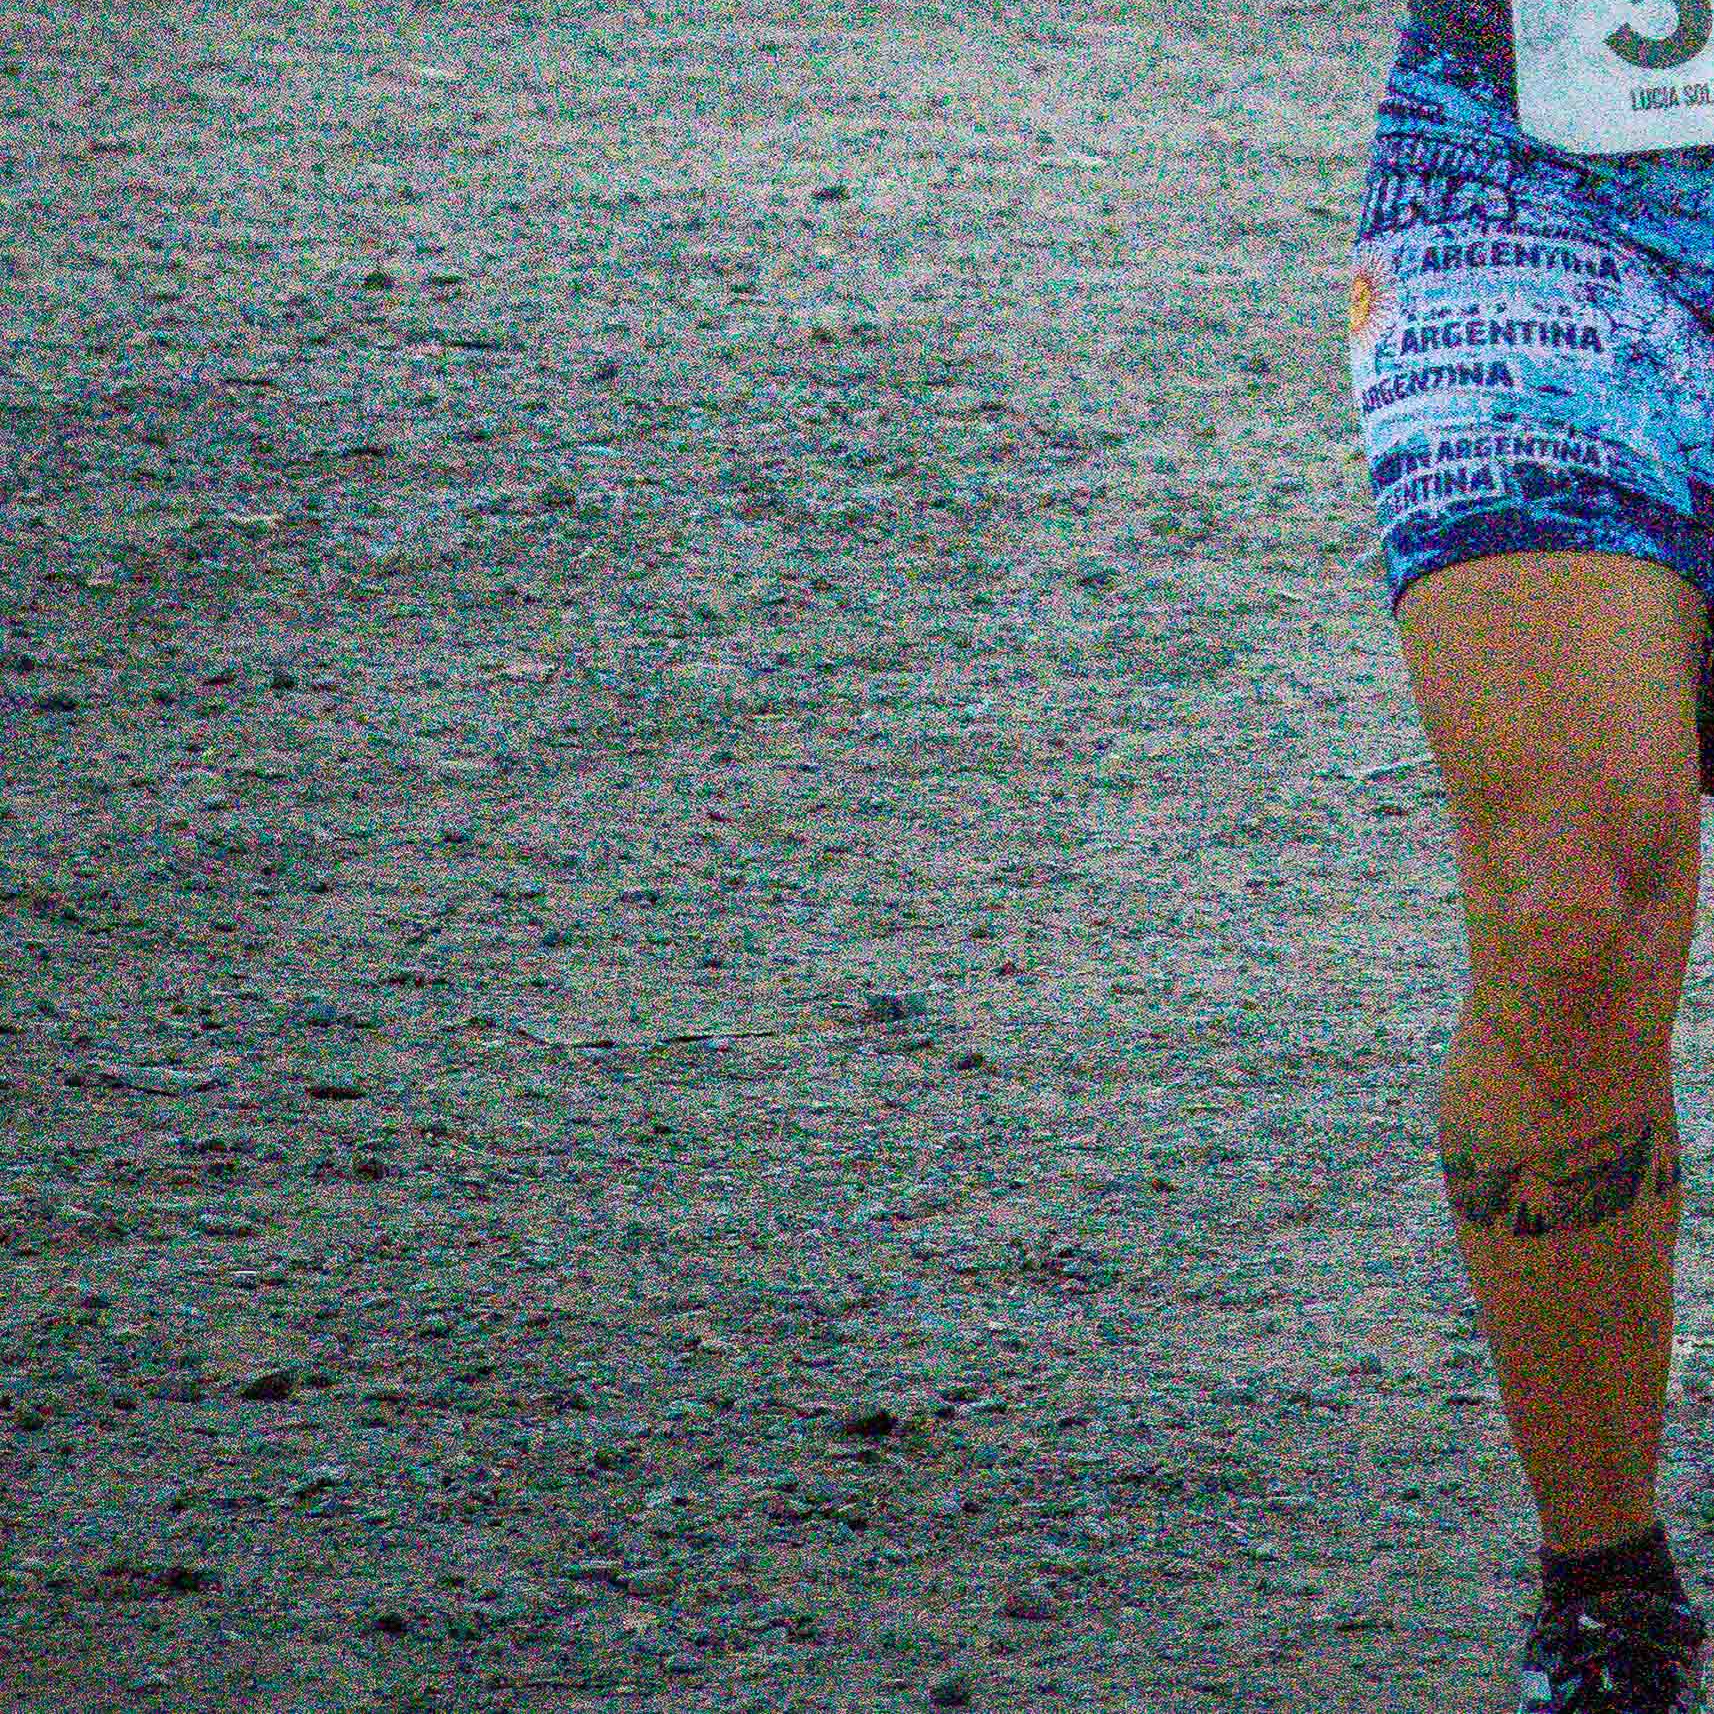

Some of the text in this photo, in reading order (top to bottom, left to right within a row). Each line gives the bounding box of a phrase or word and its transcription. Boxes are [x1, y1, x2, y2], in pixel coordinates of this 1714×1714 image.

[1421, 239, 1622, 284] ARGENTINA
[1400, 319, 1605, 357] ARGENTINA
[1437, 434, 1602, 468] ARGENTINA
